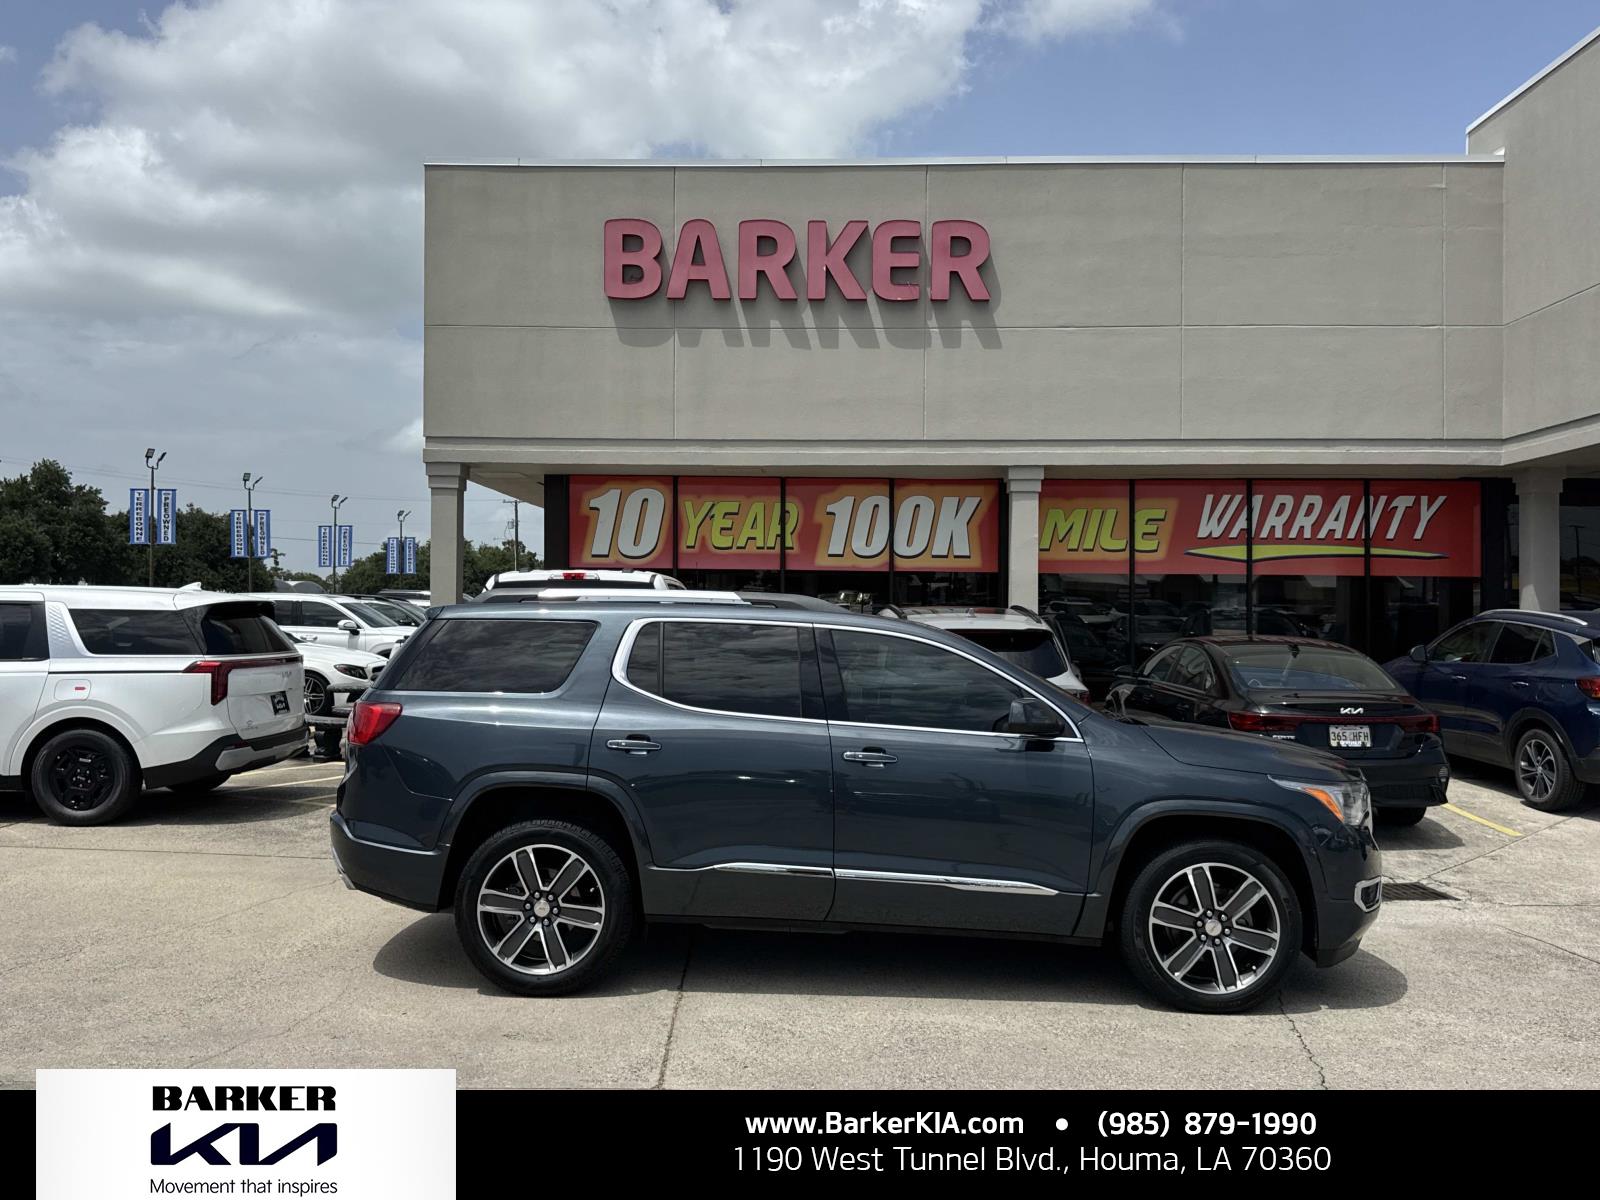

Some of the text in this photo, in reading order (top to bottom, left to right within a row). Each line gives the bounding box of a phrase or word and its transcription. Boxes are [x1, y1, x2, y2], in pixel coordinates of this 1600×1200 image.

[603, 218, 991, 302] BARKER
[135, 492, 144, 541] TERREBONNE
[163, 497, 171, 541] PREOWNED
[588, 487, 1447, 559] 10 YEAR 100K MILE WARRANTY
[1331, 732, 1347, 741] 365
